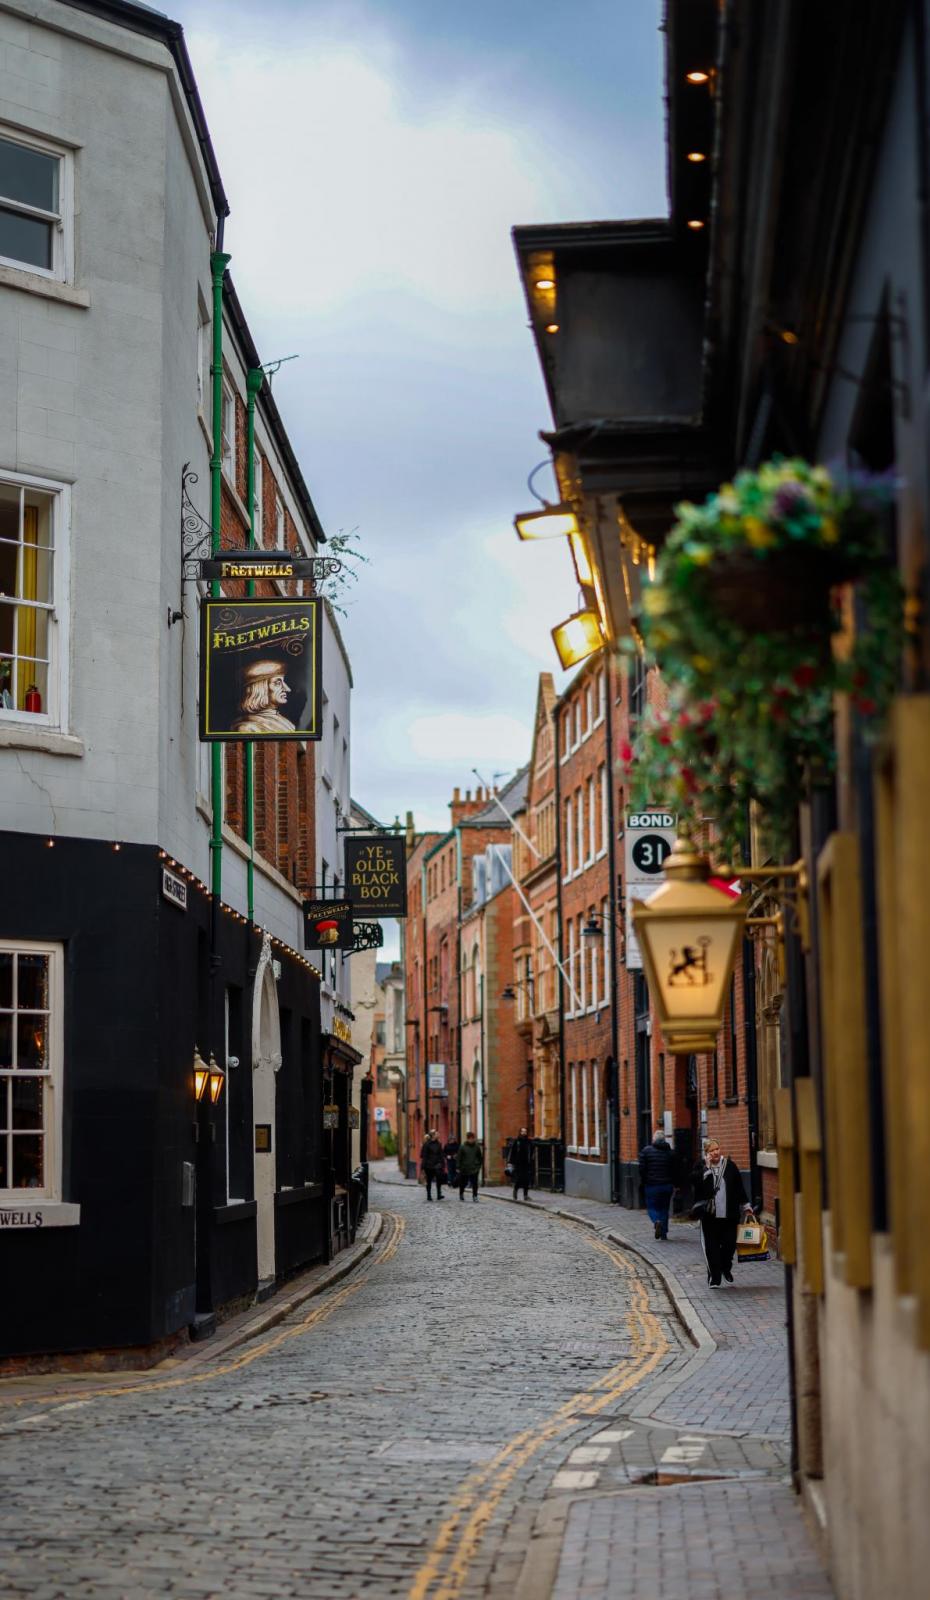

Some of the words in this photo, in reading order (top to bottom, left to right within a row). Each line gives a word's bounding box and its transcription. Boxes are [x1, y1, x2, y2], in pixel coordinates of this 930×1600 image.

[221, 562, 293, 577] FRETWELLS
[213, 617, 310, 649] FRETWELLS
[629, 814, 674, 827] BOND
[366, 846, 384, 858] YE
[640, 843, 663, 866] 31
[356, 859, 395, 872] OLDE
[352, 873, 399, 885] BLACK
[360, 886, 391, 898] BOY
